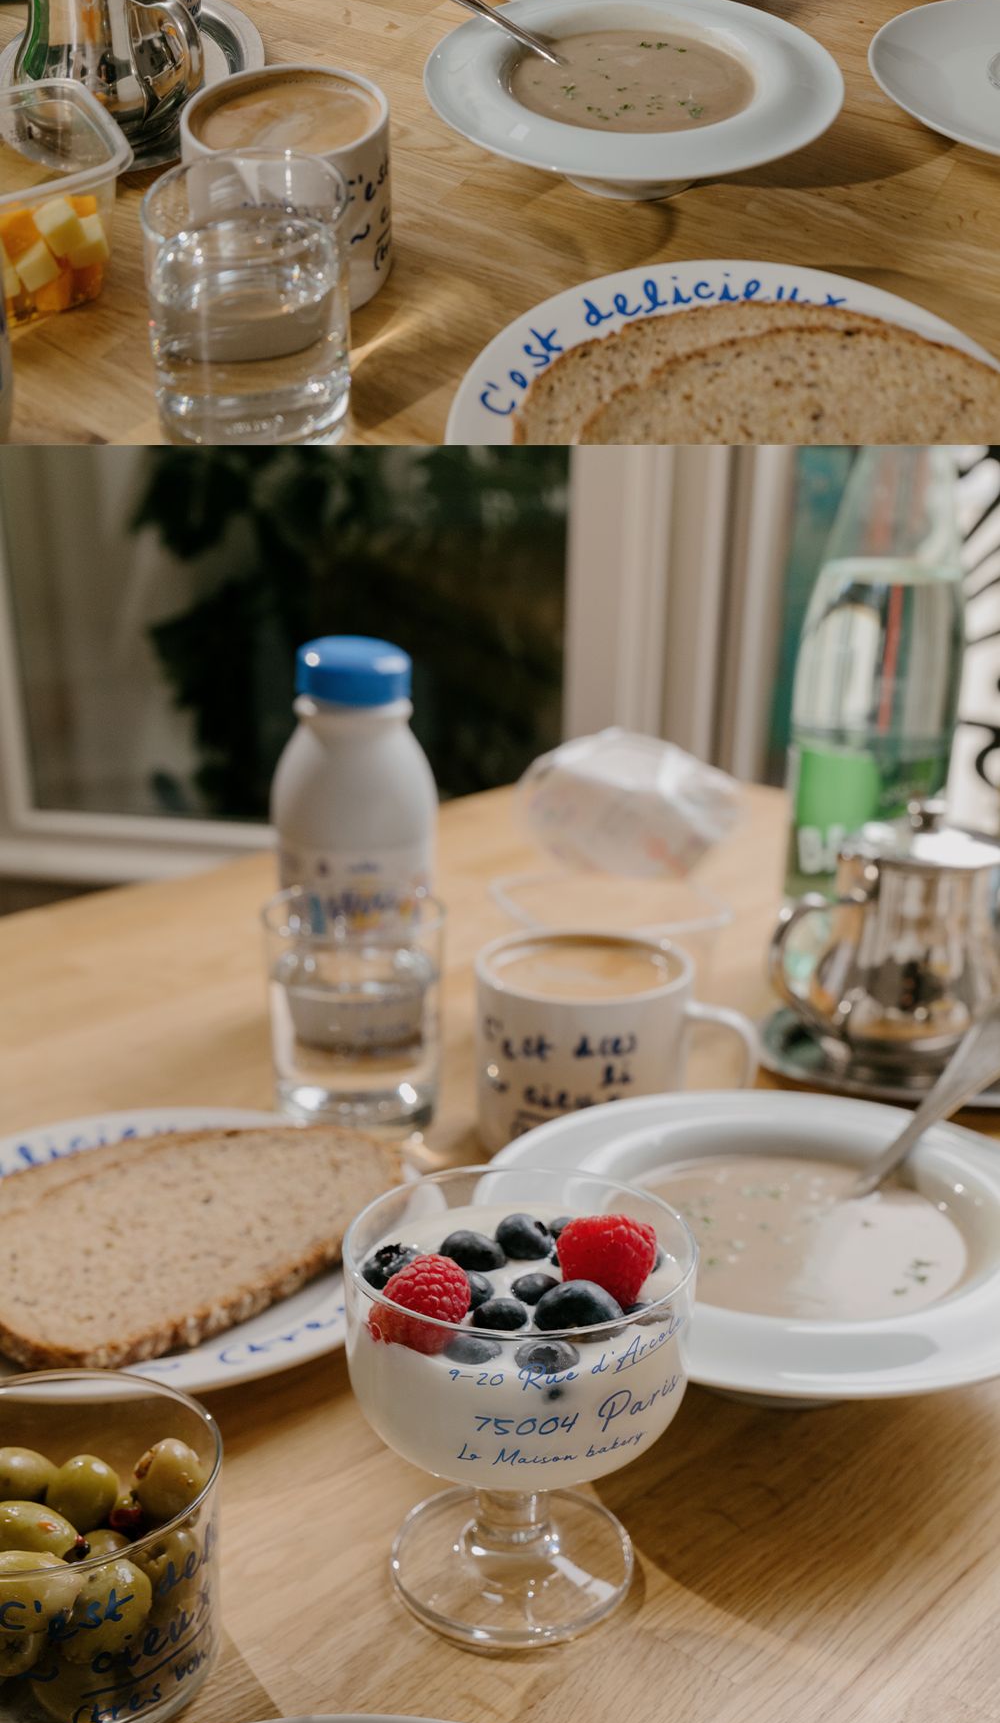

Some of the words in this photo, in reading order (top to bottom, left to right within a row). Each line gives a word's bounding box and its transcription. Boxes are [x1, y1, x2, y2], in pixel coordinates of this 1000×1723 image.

[517, 1361, 580, 1392] Rue
[474, 1411, 580, 1437] 75004
[492, 1447, 578, 1467] Maison
